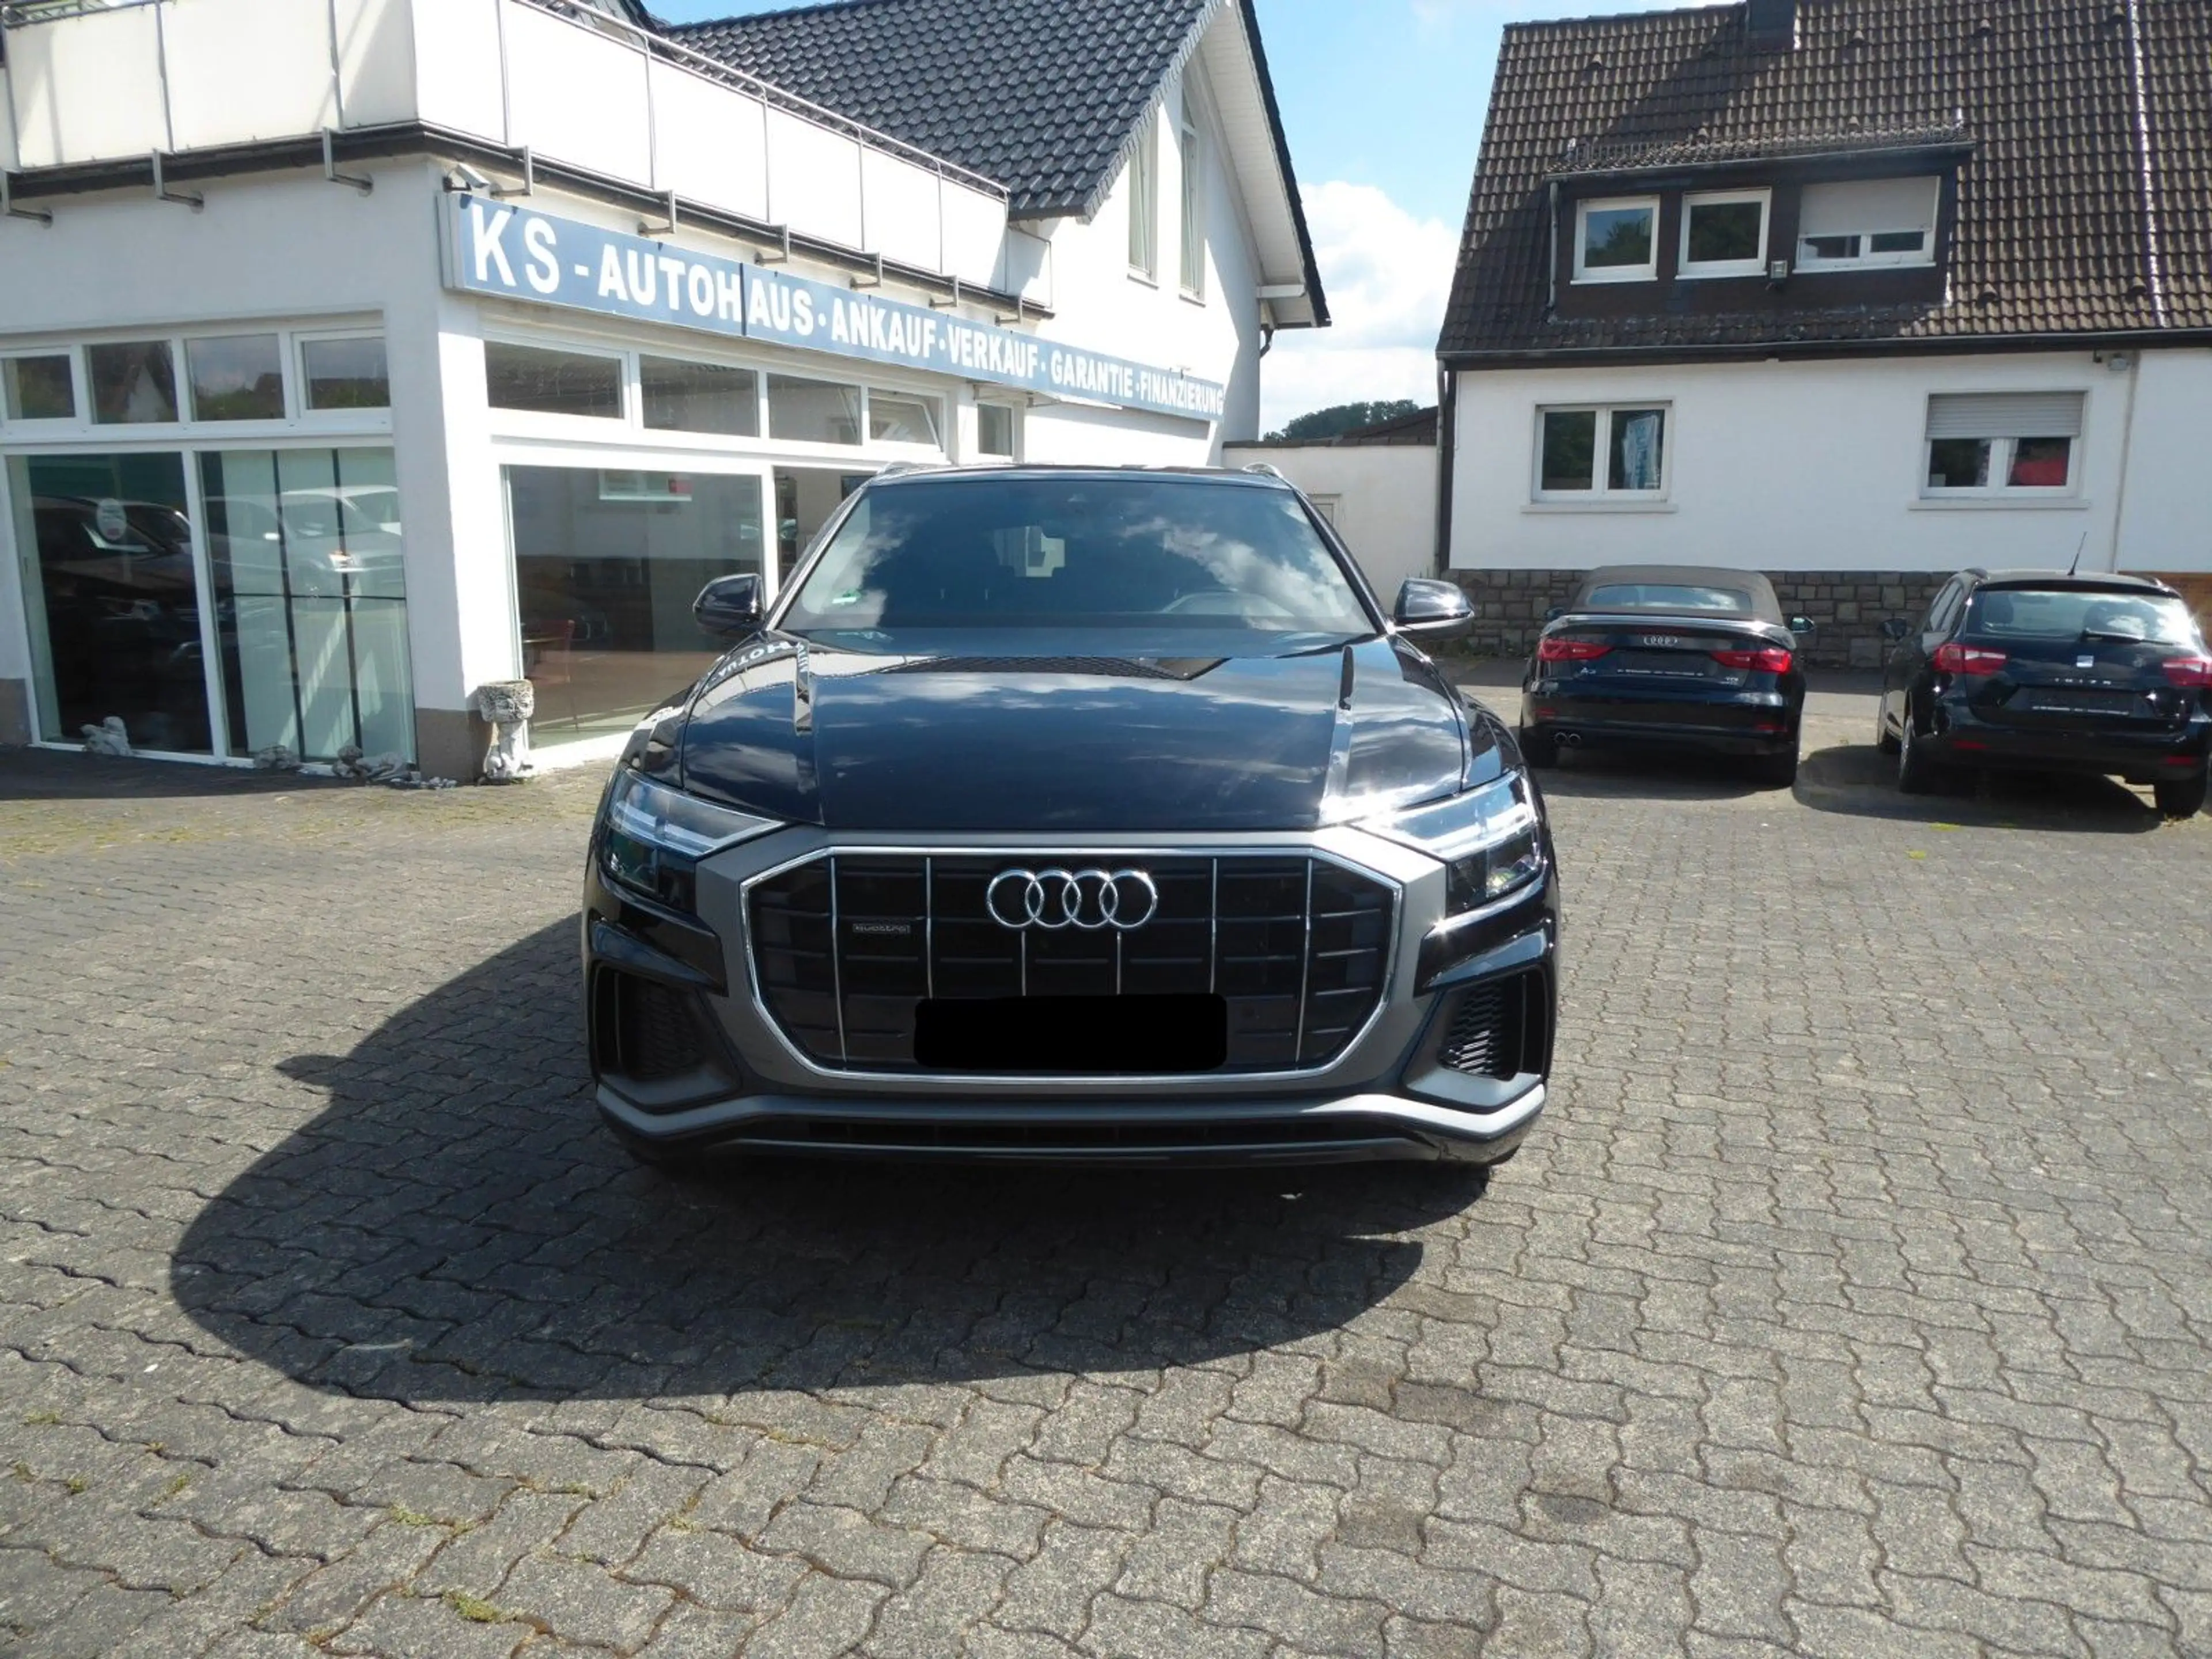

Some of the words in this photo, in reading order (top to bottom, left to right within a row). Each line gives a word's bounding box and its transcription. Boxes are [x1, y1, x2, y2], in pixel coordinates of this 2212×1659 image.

[831, 297, 937, 358] ANKAUF
[947, 323, 1038, 379] VERKAUF
[1050, 349, 1133, 398] GARANTIE
[1139, 371, 1224, 415] FINANZIERUNG
